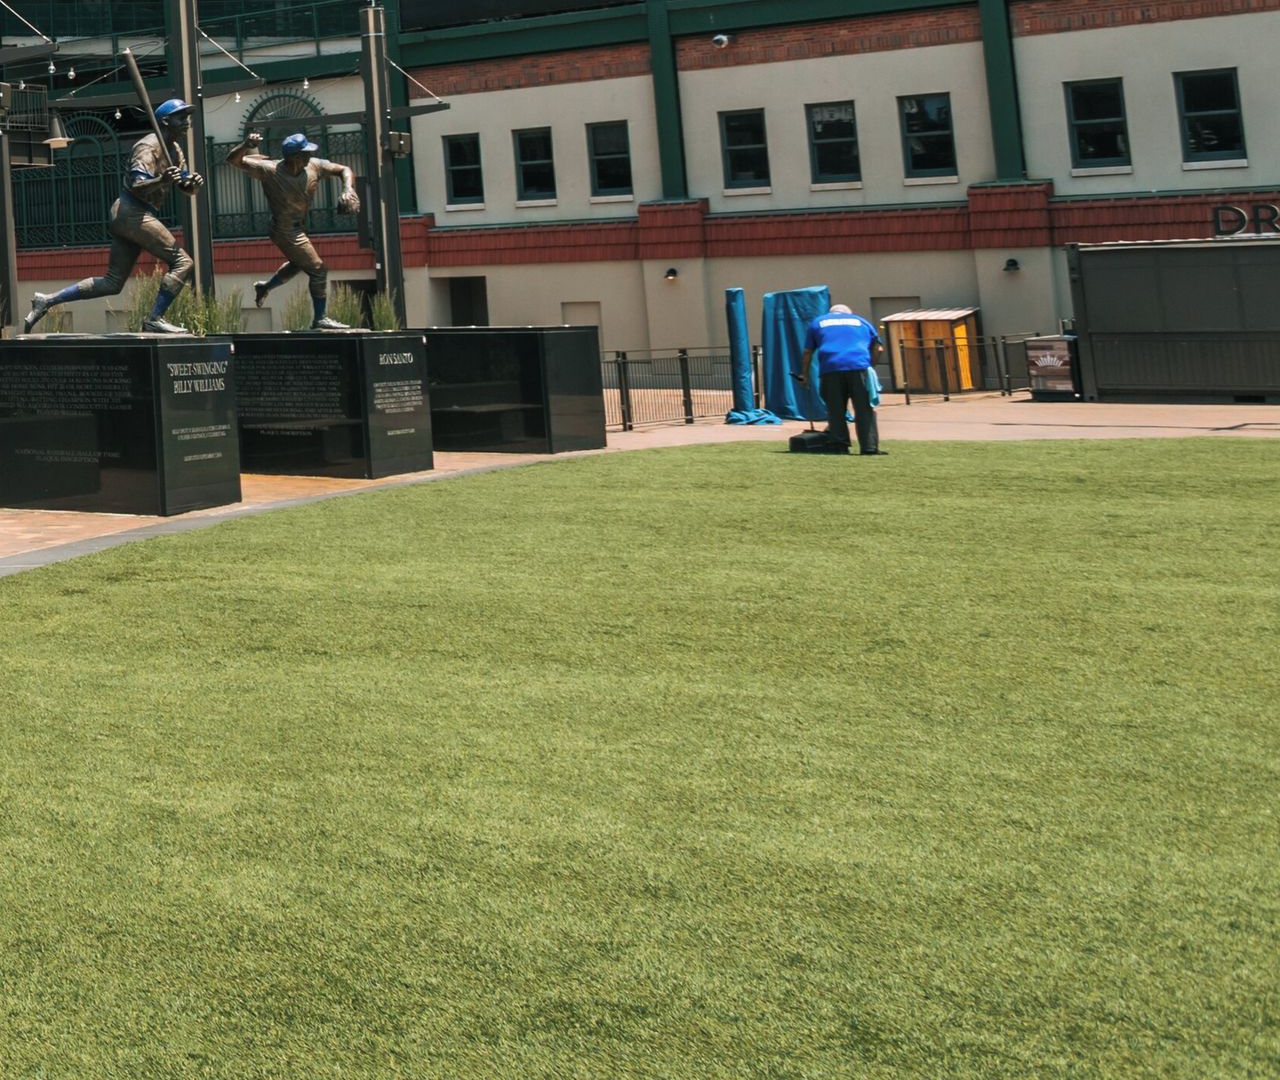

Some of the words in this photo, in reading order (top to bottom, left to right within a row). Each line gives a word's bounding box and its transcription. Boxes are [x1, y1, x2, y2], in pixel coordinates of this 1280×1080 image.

[379, 354, 393, 365] RON
[394, 352, 414, 364] SANTO
[167, 361, 228, 376] "SWEET-SWINGING"
[174, 380, 192, 393] BILLY
[193, 378, 225, 392] WILLIAMS
